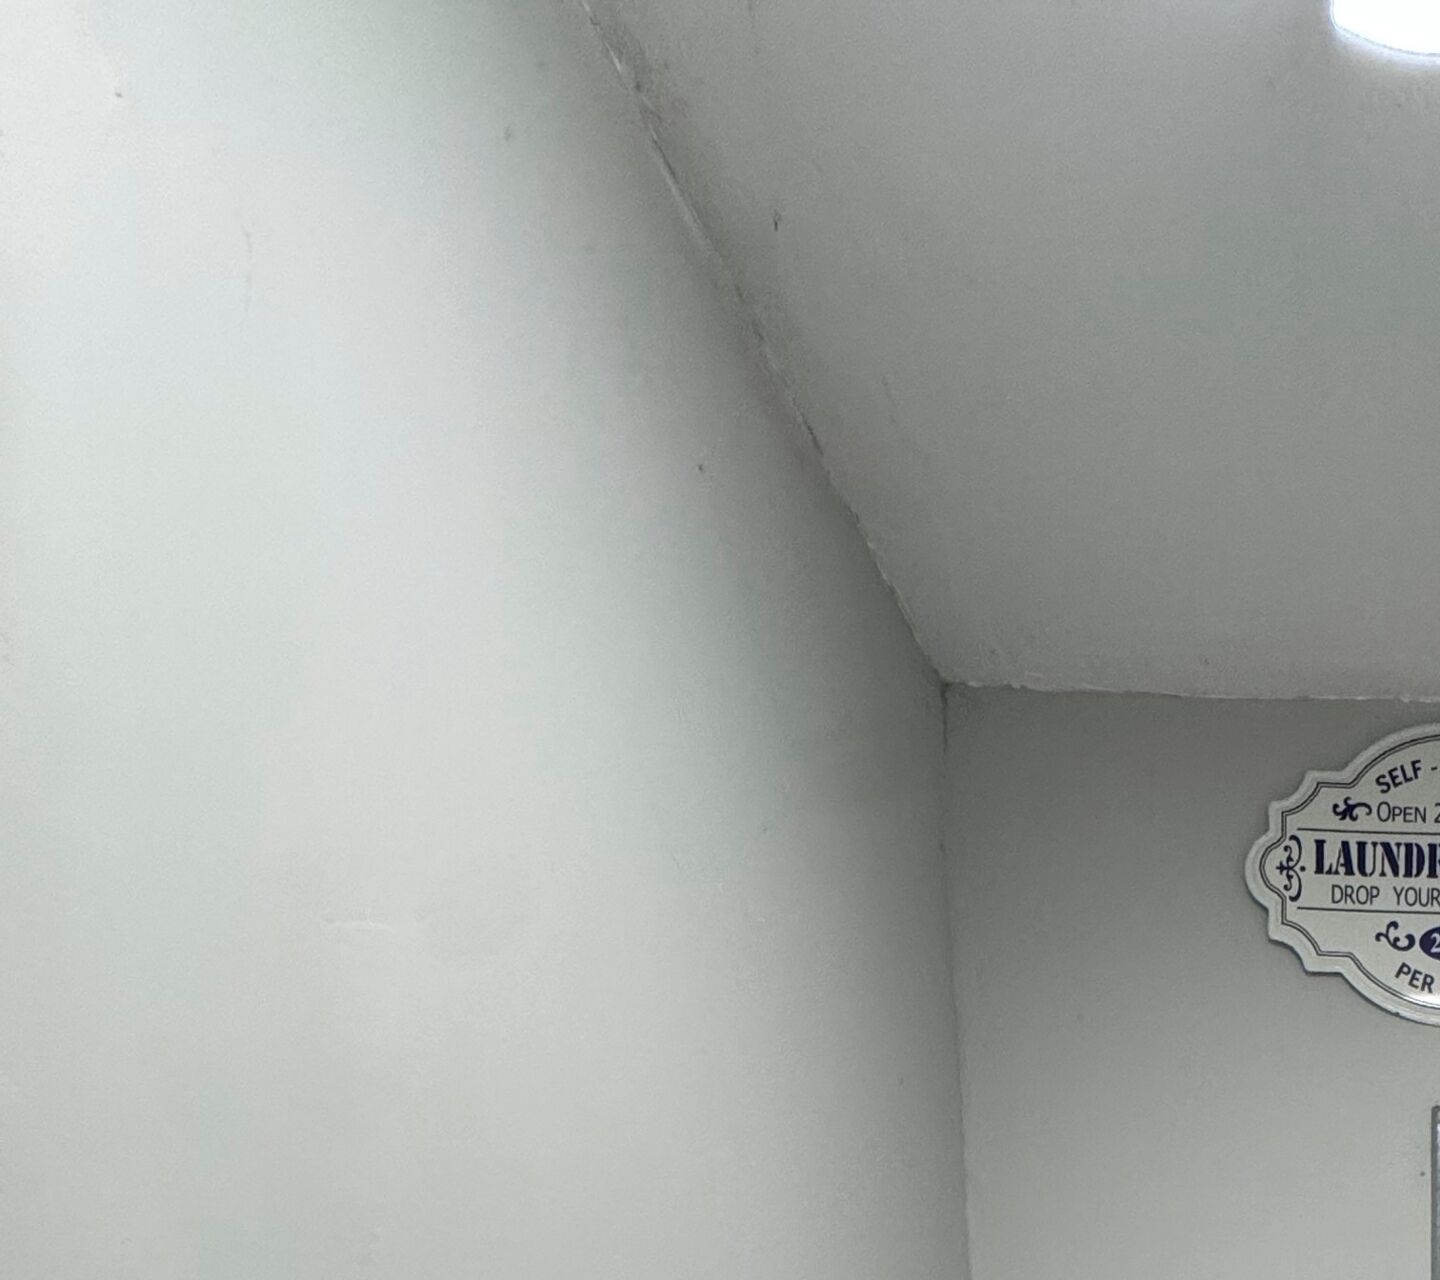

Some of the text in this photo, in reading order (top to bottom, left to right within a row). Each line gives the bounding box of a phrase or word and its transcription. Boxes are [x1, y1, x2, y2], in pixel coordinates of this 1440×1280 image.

[1374, 758, 1422, 795] SELF
[1376, 801, 1427, 824] OPEN
[1331, 884, 1380, 906] DROP
[1394, 961, 1435, 994] PER
